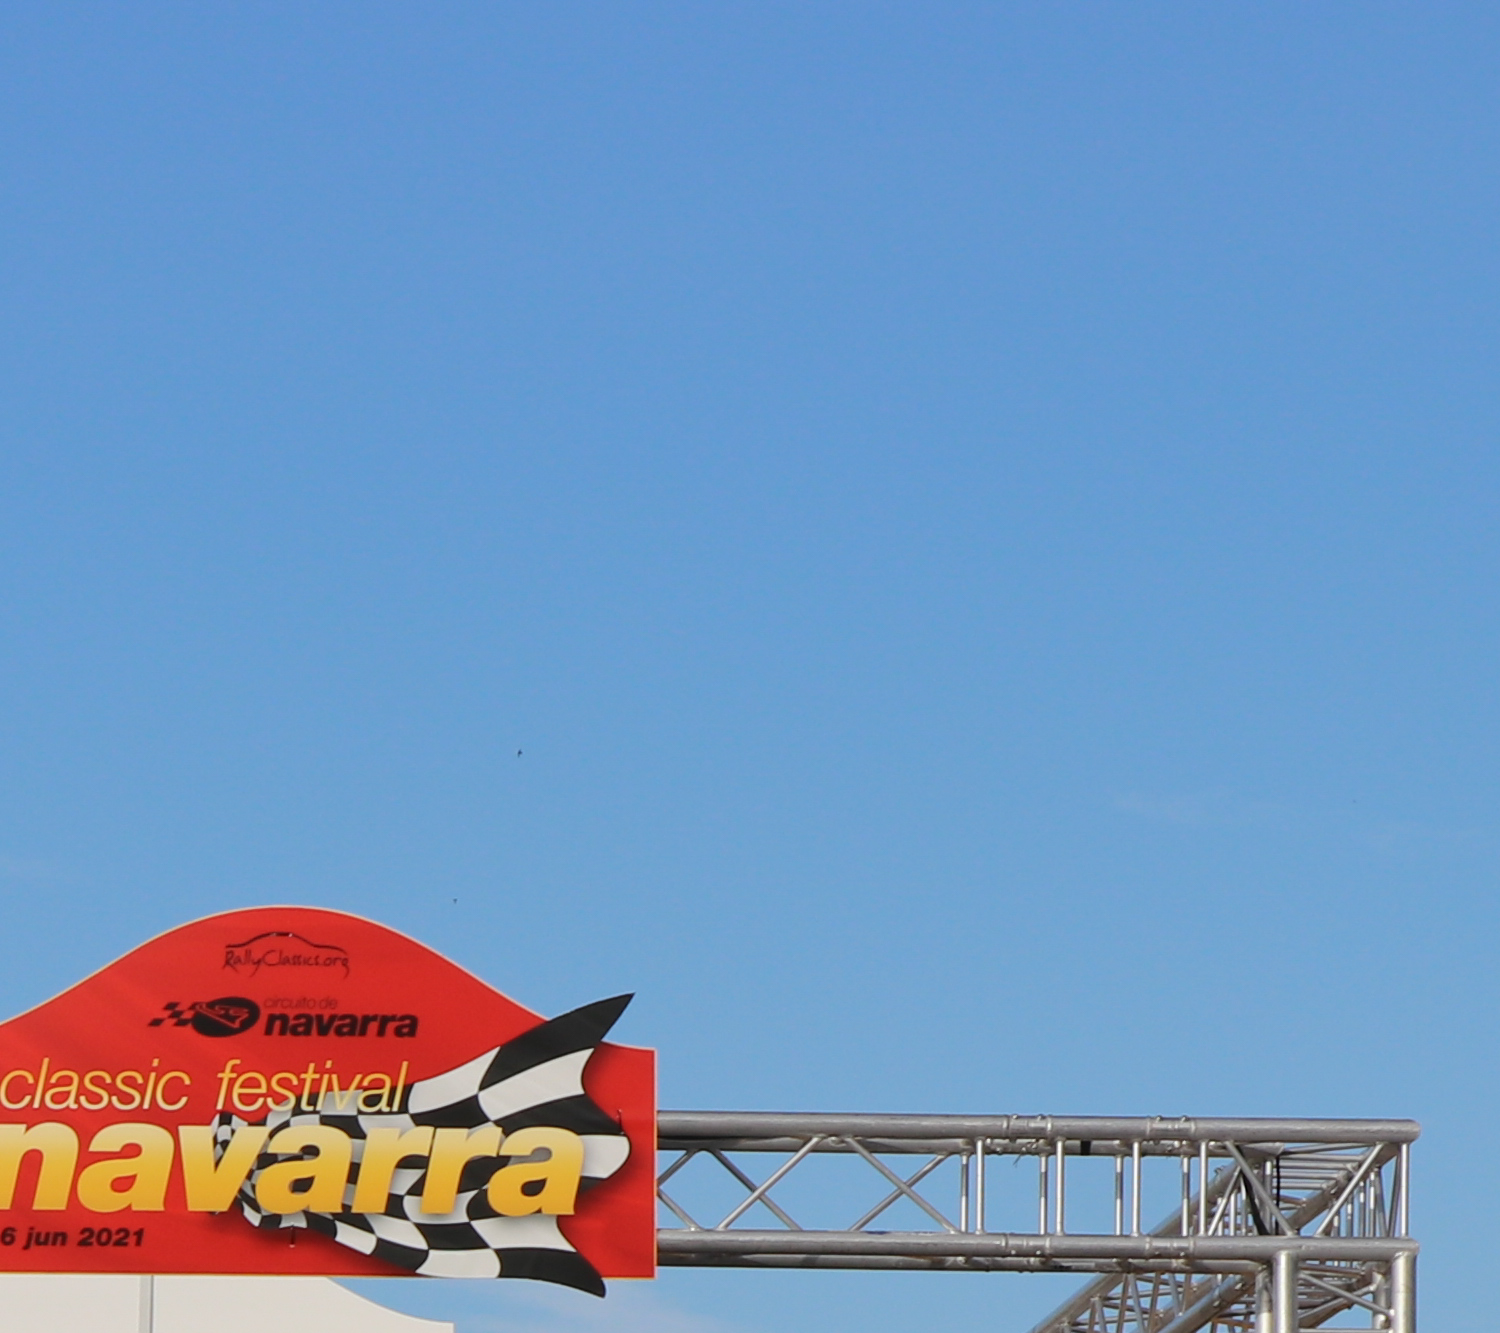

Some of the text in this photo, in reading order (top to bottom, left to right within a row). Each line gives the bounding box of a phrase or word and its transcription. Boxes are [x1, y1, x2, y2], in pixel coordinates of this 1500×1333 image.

[222, 950, 350, 979] RallyClassics.org
[264, 996, 338, 1010] circuito de
[263, 1012, 419, 1038] navarra
[0, 1057, 409, 1113] classic festival
[23, 1227, 69, 1250] jun
[77, 1227, 146, 1247] 2021
